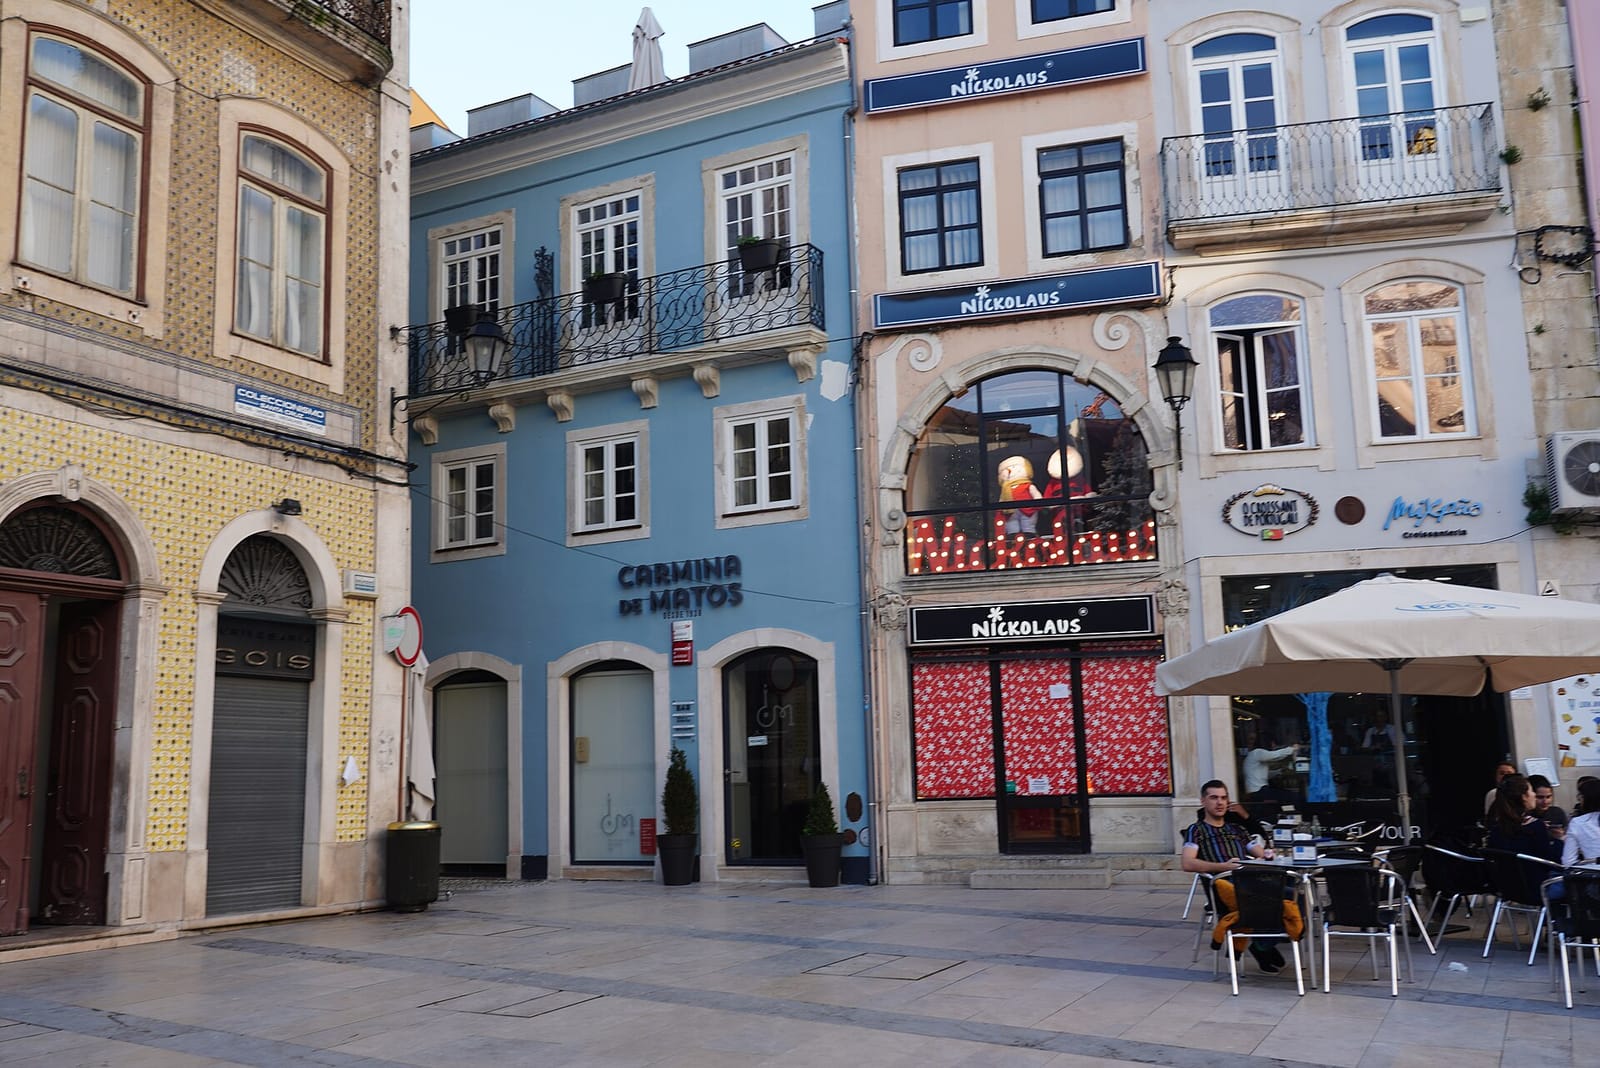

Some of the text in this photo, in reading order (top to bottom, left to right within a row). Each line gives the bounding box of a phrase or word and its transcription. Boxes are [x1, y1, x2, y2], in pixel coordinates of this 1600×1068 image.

[950, 68, 1048, 96] NICKOLAUS
[961, 286, 1060, 314] NICKOLAUS
[236, 388, 325, 418] COLECCIONISMO
[1243, 514, 1255, 526] DE
[1250, 500, 1298, 515] CROISSANT
[618, 554, 742, 589] CARMINA
[619, 583, 743, 616] DE MATOS
[971, 606, 1081, 637] NICKOLAUS
